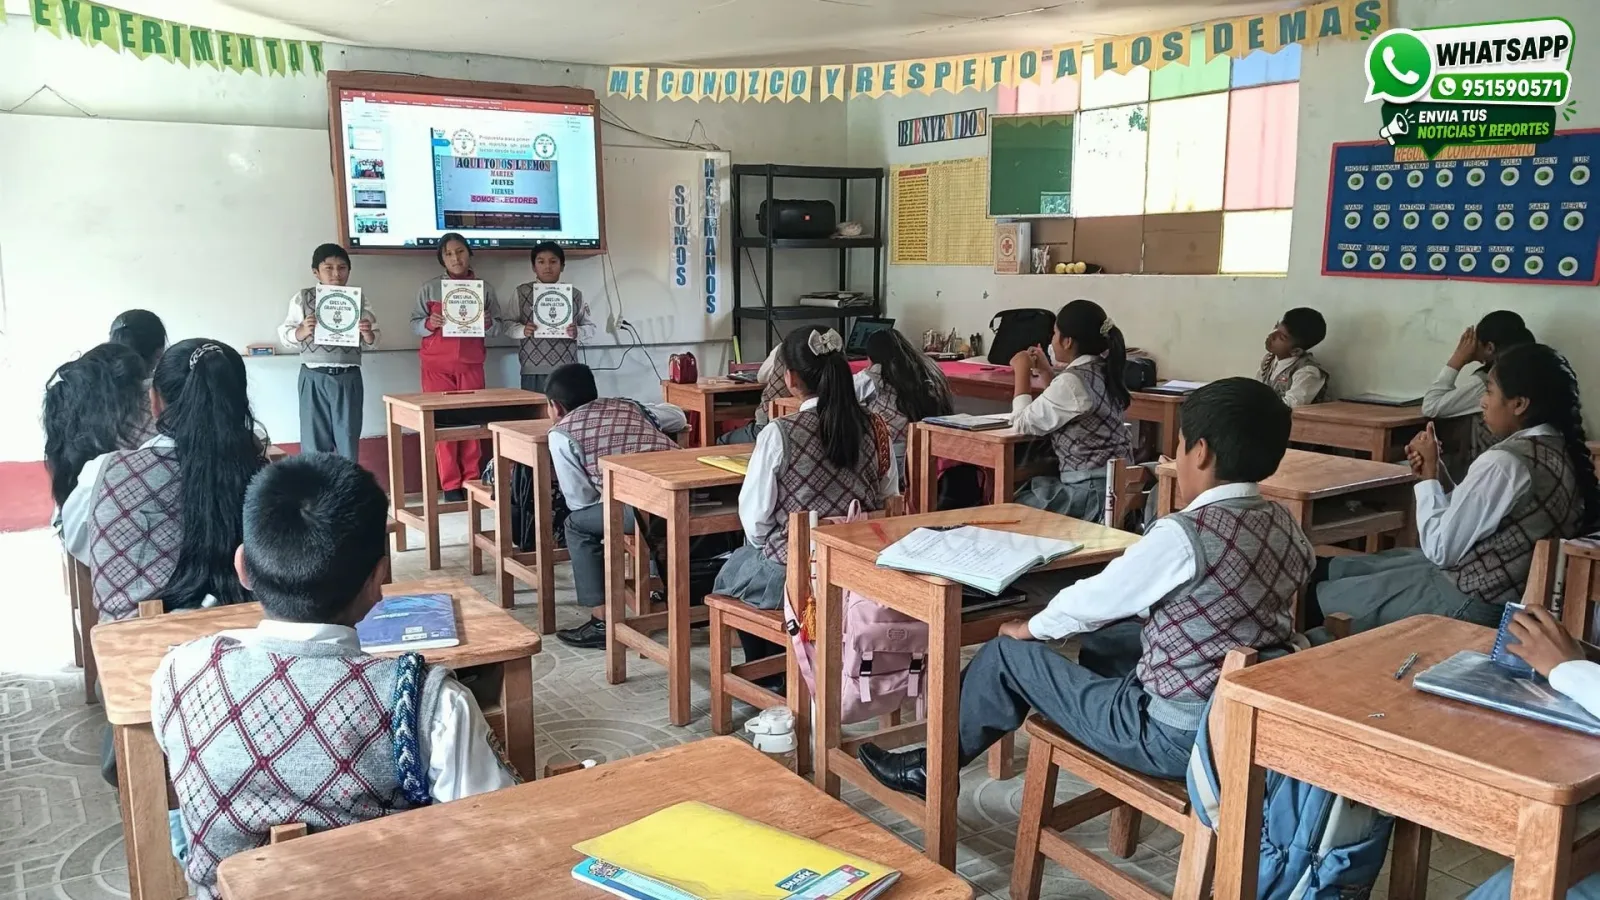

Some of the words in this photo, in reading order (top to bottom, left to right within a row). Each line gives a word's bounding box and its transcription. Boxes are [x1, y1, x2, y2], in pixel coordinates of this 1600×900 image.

[609, 69, 645, 94] ME
[661, 69, 807, 94] CONOZCO
[825, 68, 841, 93] Y
[856, 50, 1036, 93] RESPETO
[1056, 49, 1078, 78] A
[1103, 32, 1184, 71] LOS
[1213, 1, 1381, 54] DEMAS
[900, 110, 985, 145] BIENVENIDOS
[456, 158, 480, 169] AQUI
[471, 195, 495, 203] SOMOS
[1529, 202, 1549, 210] GARY
[674, 185, 688, 286] SOMOS
[704, 158, 717, 314] HERMANOS
